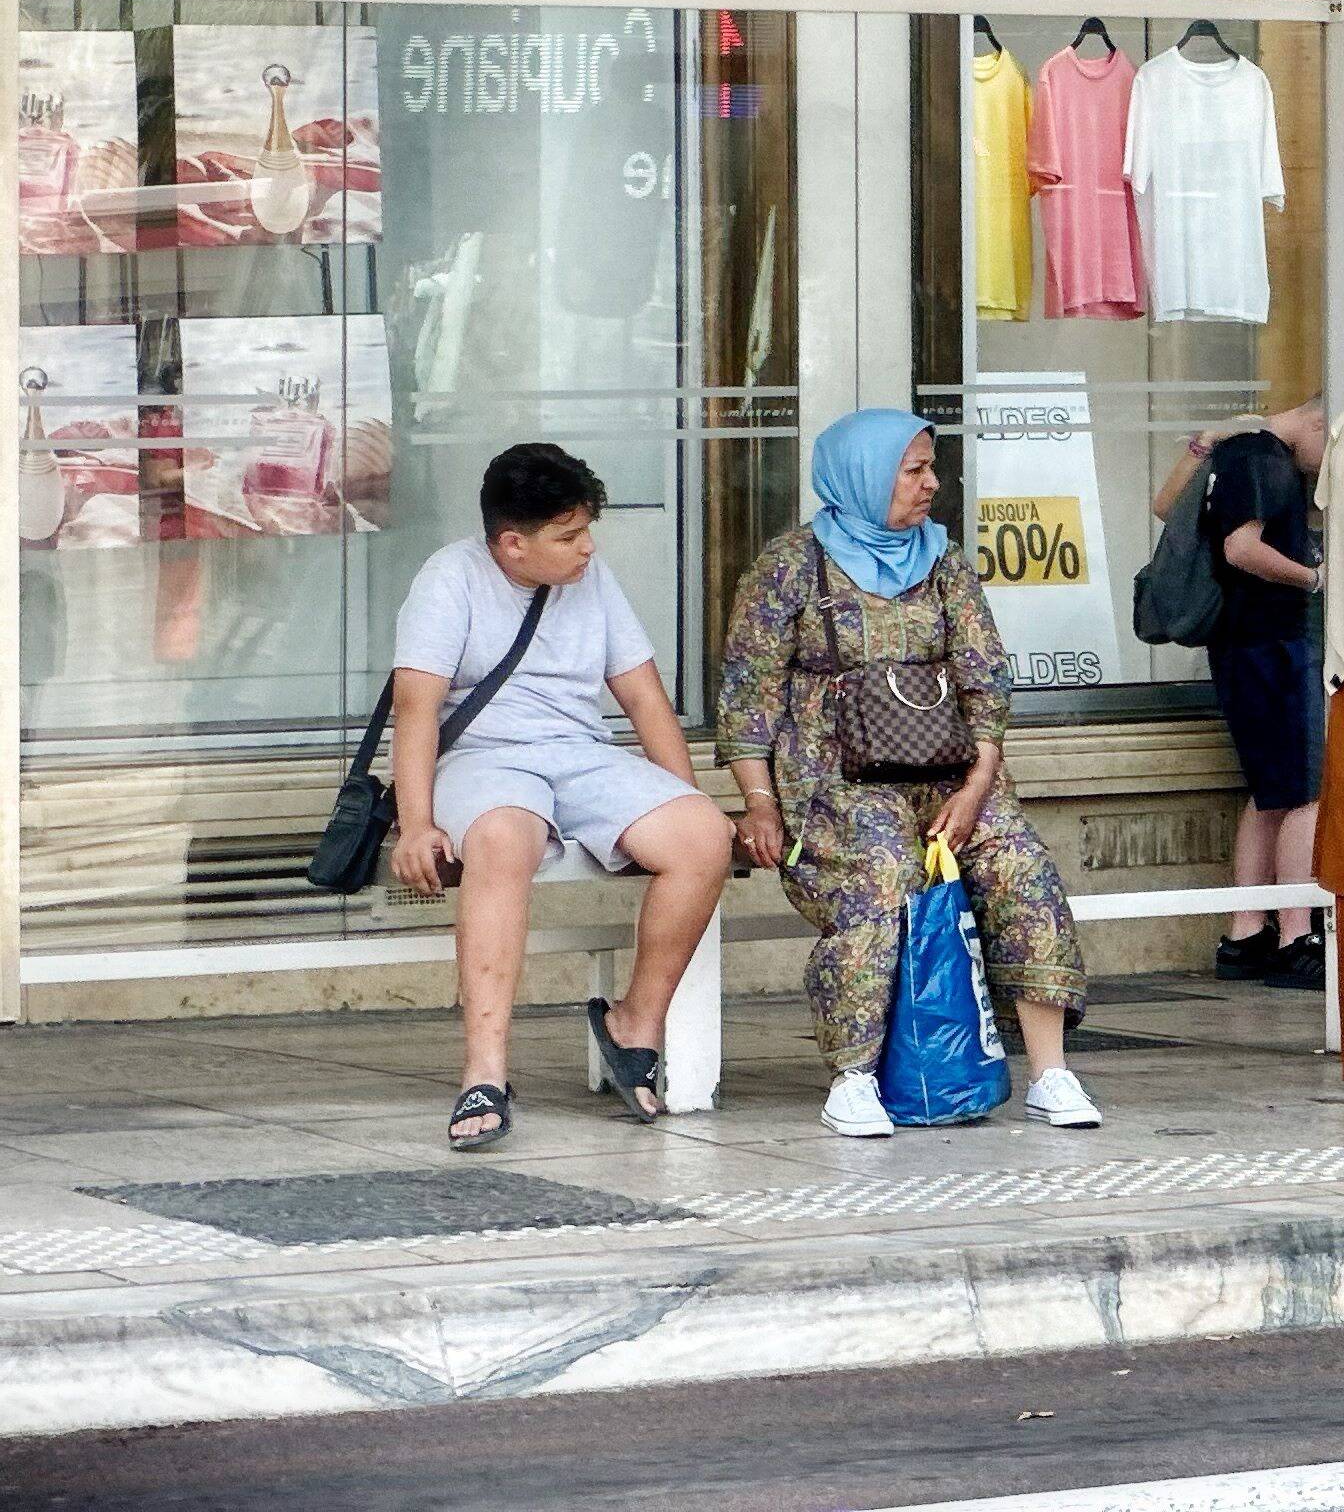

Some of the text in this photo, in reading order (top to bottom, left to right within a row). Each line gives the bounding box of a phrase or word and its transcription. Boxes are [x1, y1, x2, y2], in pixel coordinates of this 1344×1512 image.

[977, 405, 1073, 441] LDES
[977, 500, 1040, 523] JUSQU'À
[1007, 651, 1102, 686] LDES
